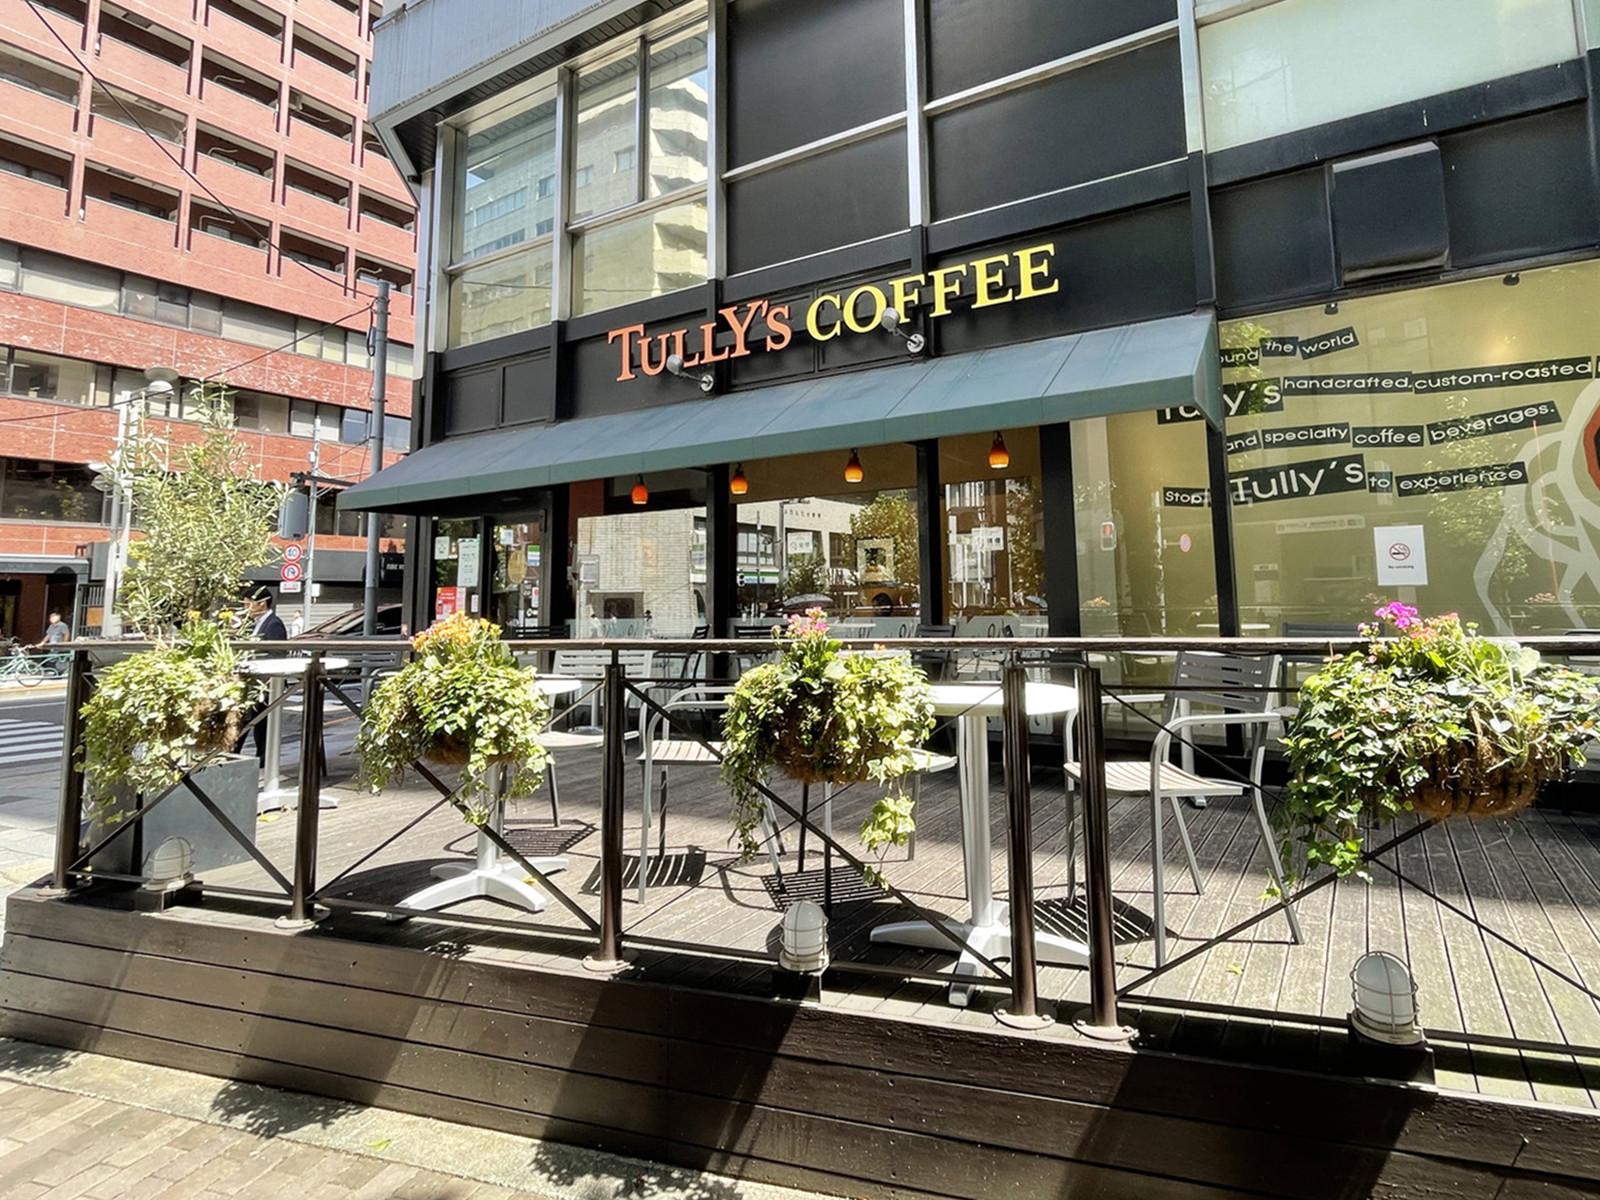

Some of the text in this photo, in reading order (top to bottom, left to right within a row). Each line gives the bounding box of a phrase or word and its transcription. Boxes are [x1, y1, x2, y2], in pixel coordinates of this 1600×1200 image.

[806, 243, 1060, 342] COFFEE
[1265, 341, 1294, 353] the
[1301, 333, 1355, 354] world
[1284, 376, 1412, 390] handcrafted,
[1414, 361, 1592, 389] custom-roasted
[1226, 404, 1555, 451] and specialty coffee beverages.
[1165, 460, 1523, 504] Stop Tully's to experience
